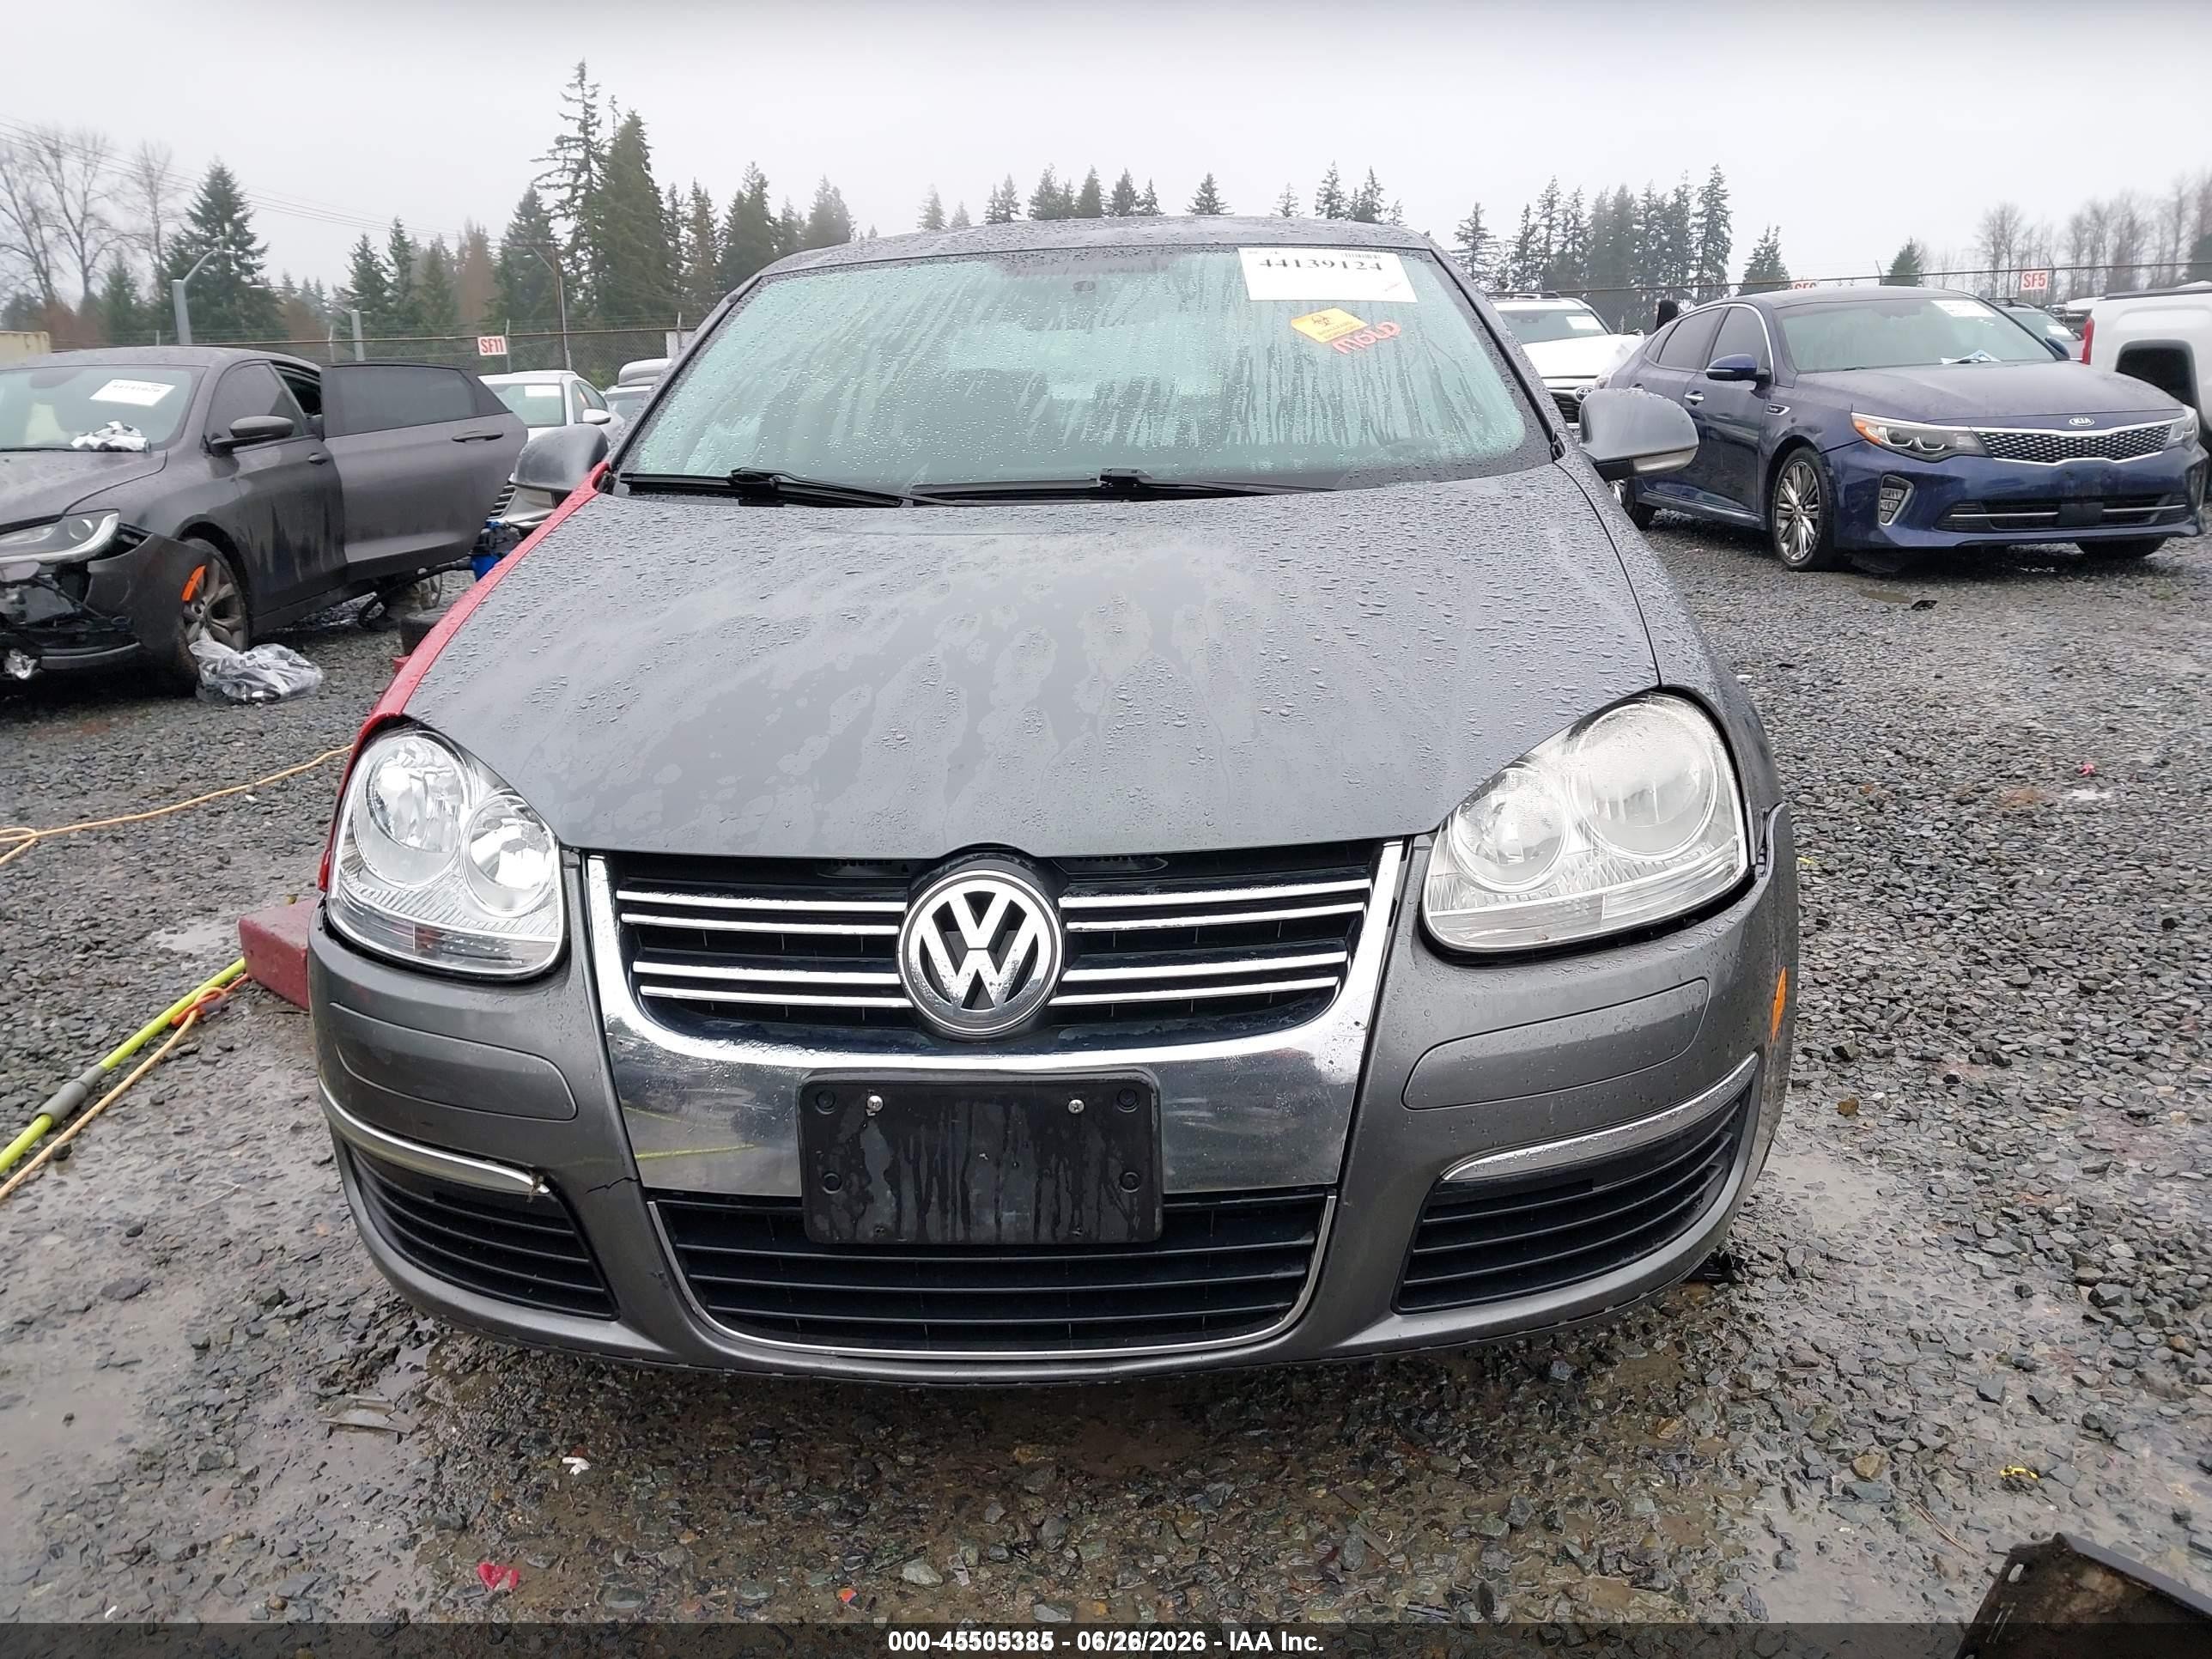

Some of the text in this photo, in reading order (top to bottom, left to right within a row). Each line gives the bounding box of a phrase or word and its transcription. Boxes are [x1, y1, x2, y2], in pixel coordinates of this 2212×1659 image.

[1259, 258, 1382, 271] 44139124
[2023, 273, 2046, 289] SF5
[480, 338, 504, 353] SF11
